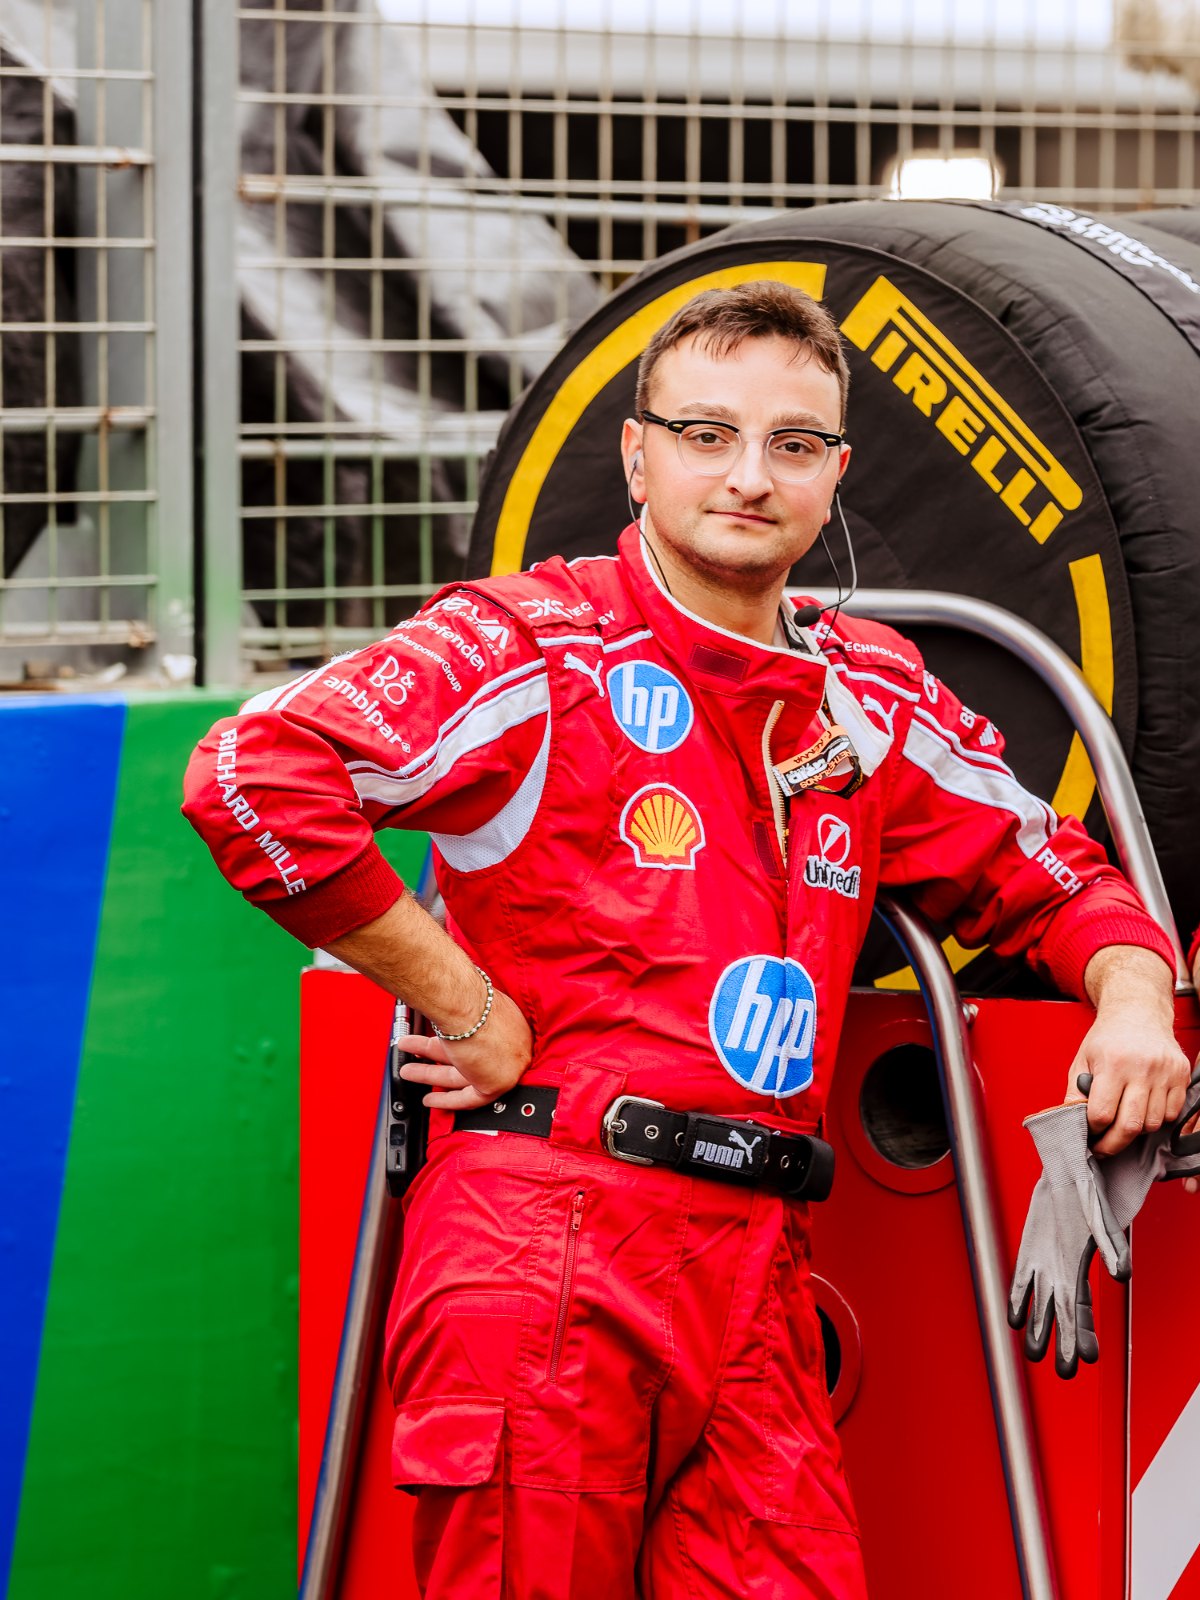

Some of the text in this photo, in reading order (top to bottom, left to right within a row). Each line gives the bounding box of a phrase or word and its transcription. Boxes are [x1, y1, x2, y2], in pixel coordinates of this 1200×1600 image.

[840, 275, 1083, 544] PIRELLI
[844, 641, 917, 672] ECHNOLOGY
[323, 675, 403, 744] ambipar
[621, 663, 680, 750] hp
[800, 749, 853, 789] NETHERLANDS
[216, 727, 307, 896] RICHARD MILLE
[1035, 846, 1084, 896] RICH
[692, 1139, 746, 1169] PUMA
